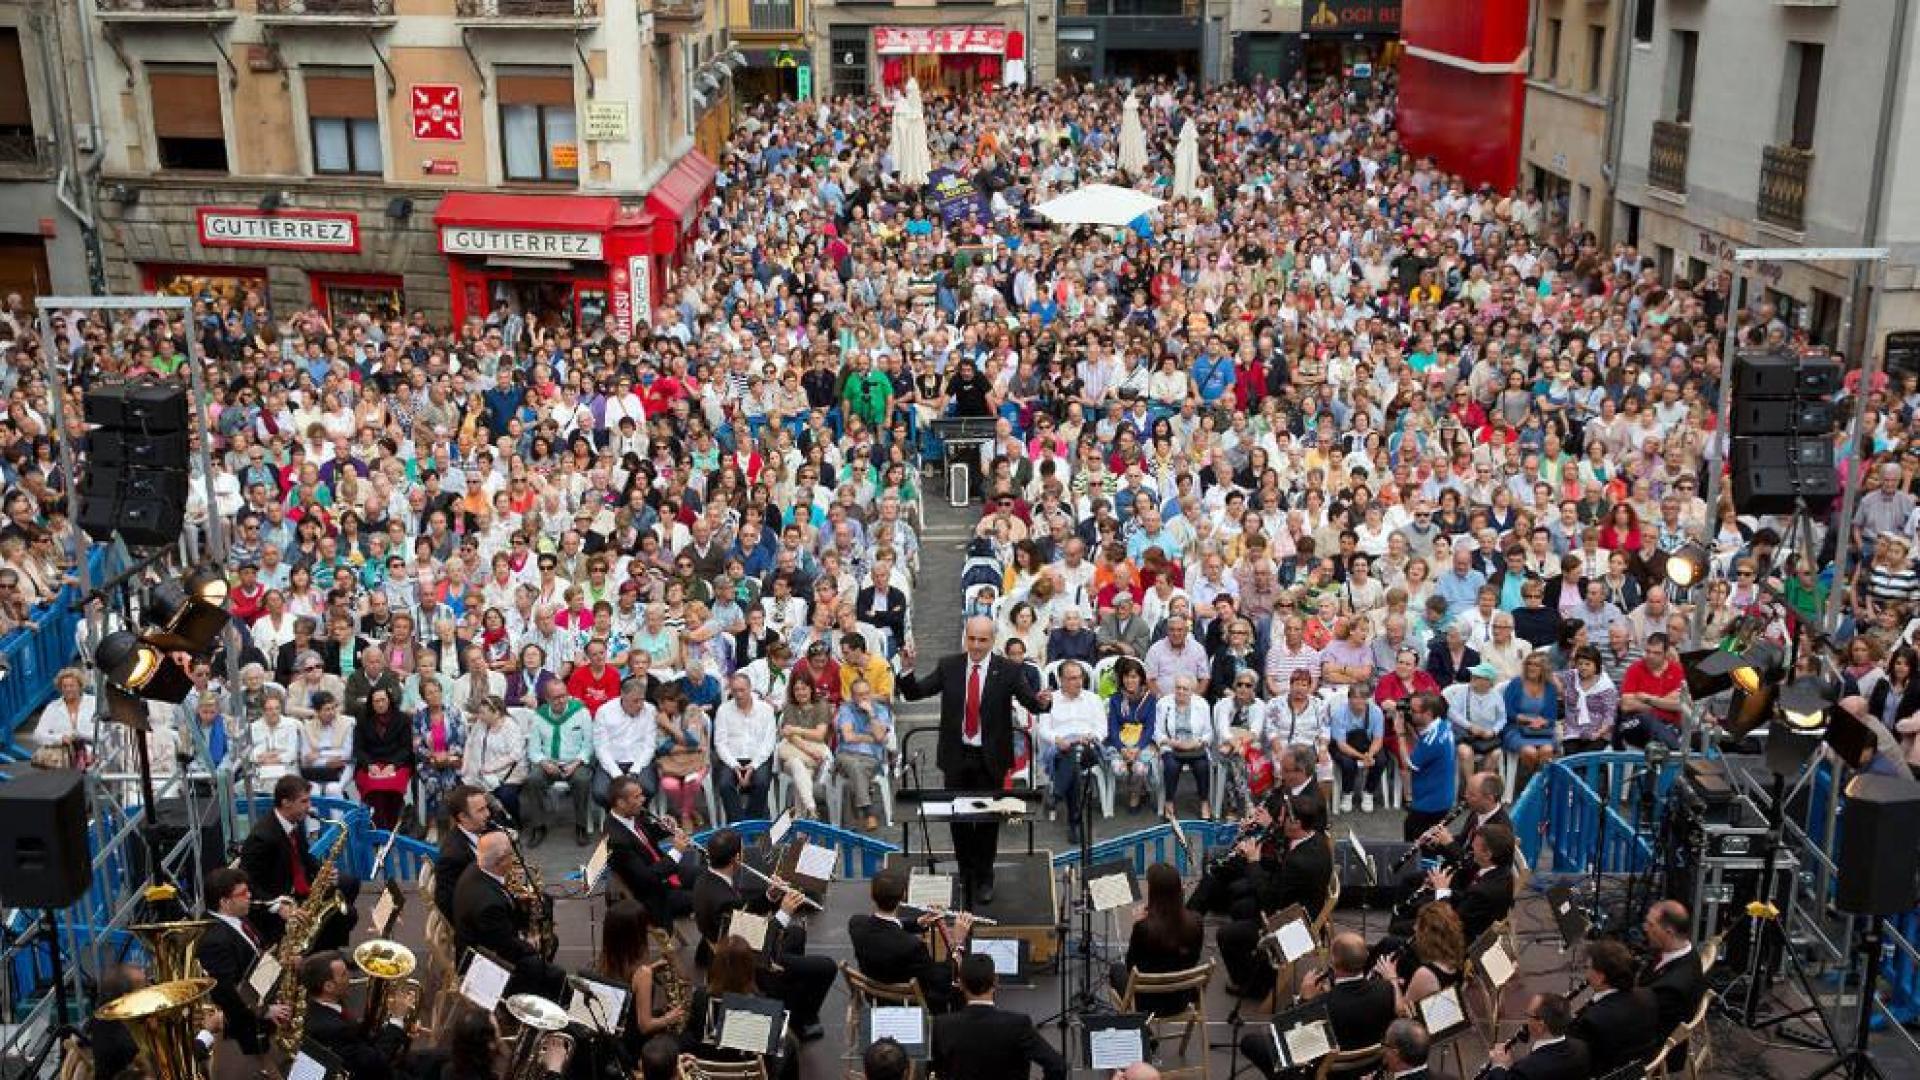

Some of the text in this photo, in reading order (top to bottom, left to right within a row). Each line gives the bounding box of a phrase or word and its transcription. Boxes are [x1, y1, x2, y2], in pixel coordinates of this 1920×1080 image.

[1261, 9, 1273, 24] 2
[212, 218, 346, 239] GUTIERREZ
[456, 231, 590, 253] GUTIERREZ
